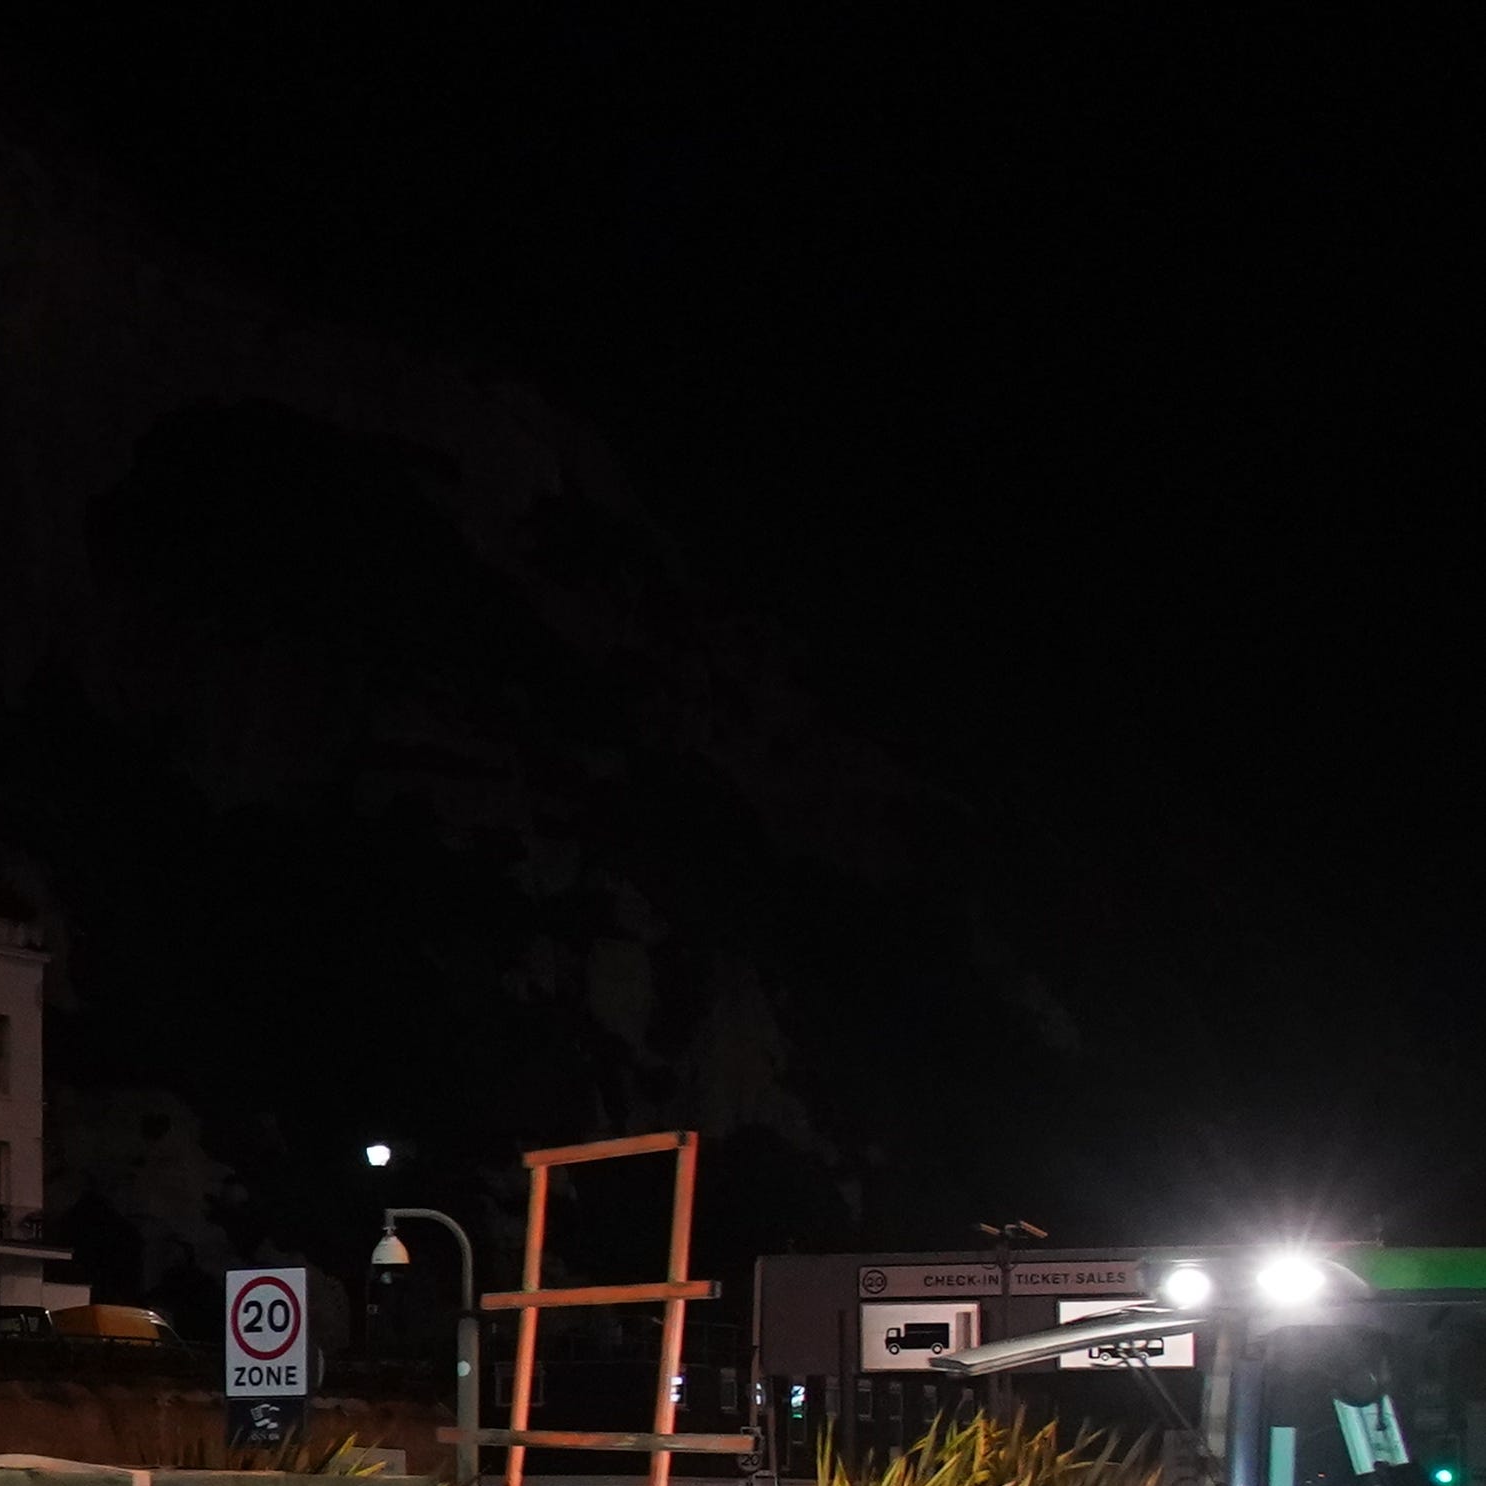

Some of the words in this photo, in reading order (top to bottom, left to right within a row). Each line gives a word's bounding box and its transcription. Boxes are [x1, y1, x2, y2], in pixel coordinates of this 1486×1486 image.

[923, 1274, 999, 1287] CHECK-IN
[1015, 1272, 1070, 1286] TICKET
[1075, 1271, 1127, 1285] SALES
[242, 1299, 290, 1334] 20
[233, 1365, 297, 1387] ZONE
